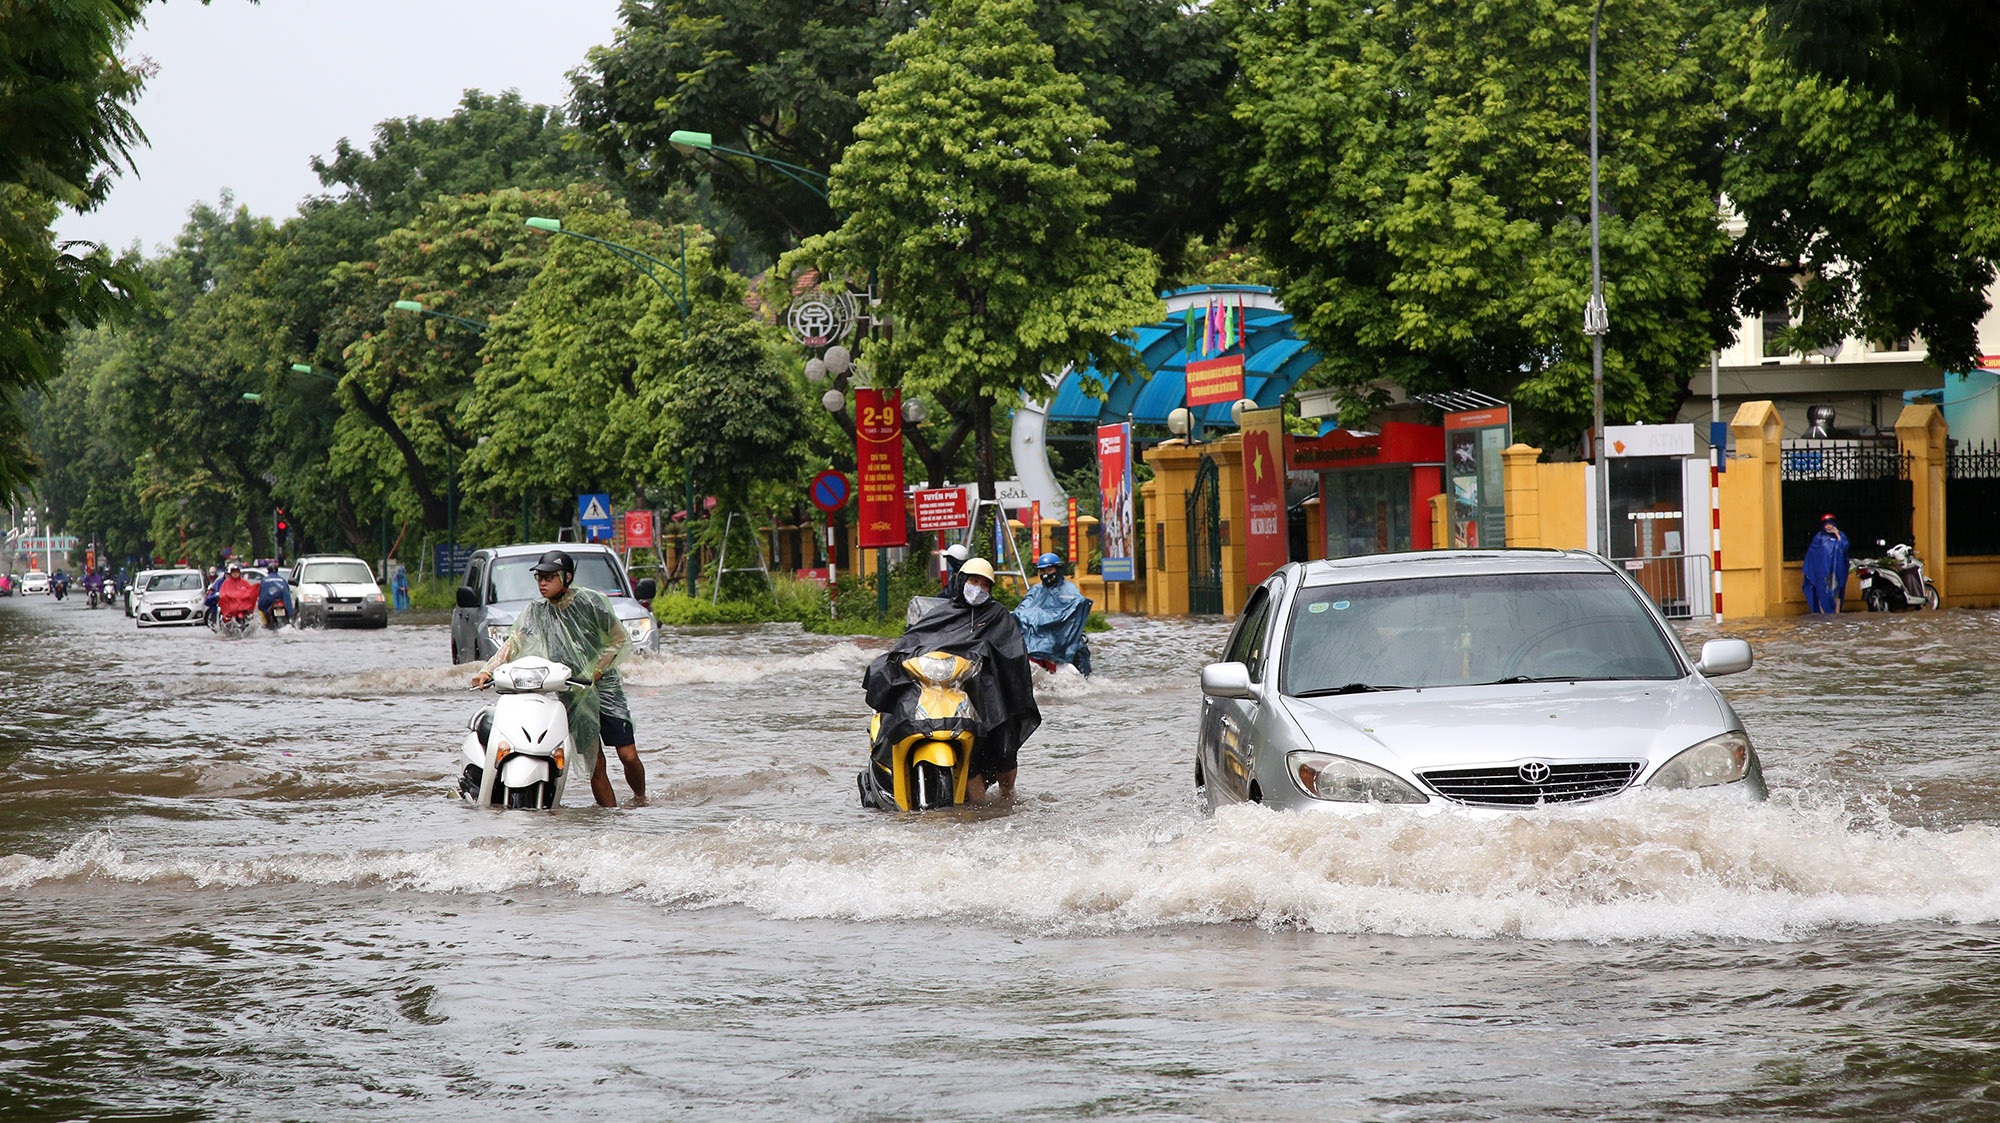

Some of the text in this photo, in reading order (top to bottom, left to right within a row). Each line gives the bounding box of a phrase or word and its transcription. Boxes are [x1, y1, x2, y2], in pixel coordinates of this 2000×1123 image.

[1984, 359, 2000, 367] CHU
[863, 406, 894, 426] 2-9
[1648, 433, 1684, 448] ATM
[944, 490, 958, 500] PHỐ
